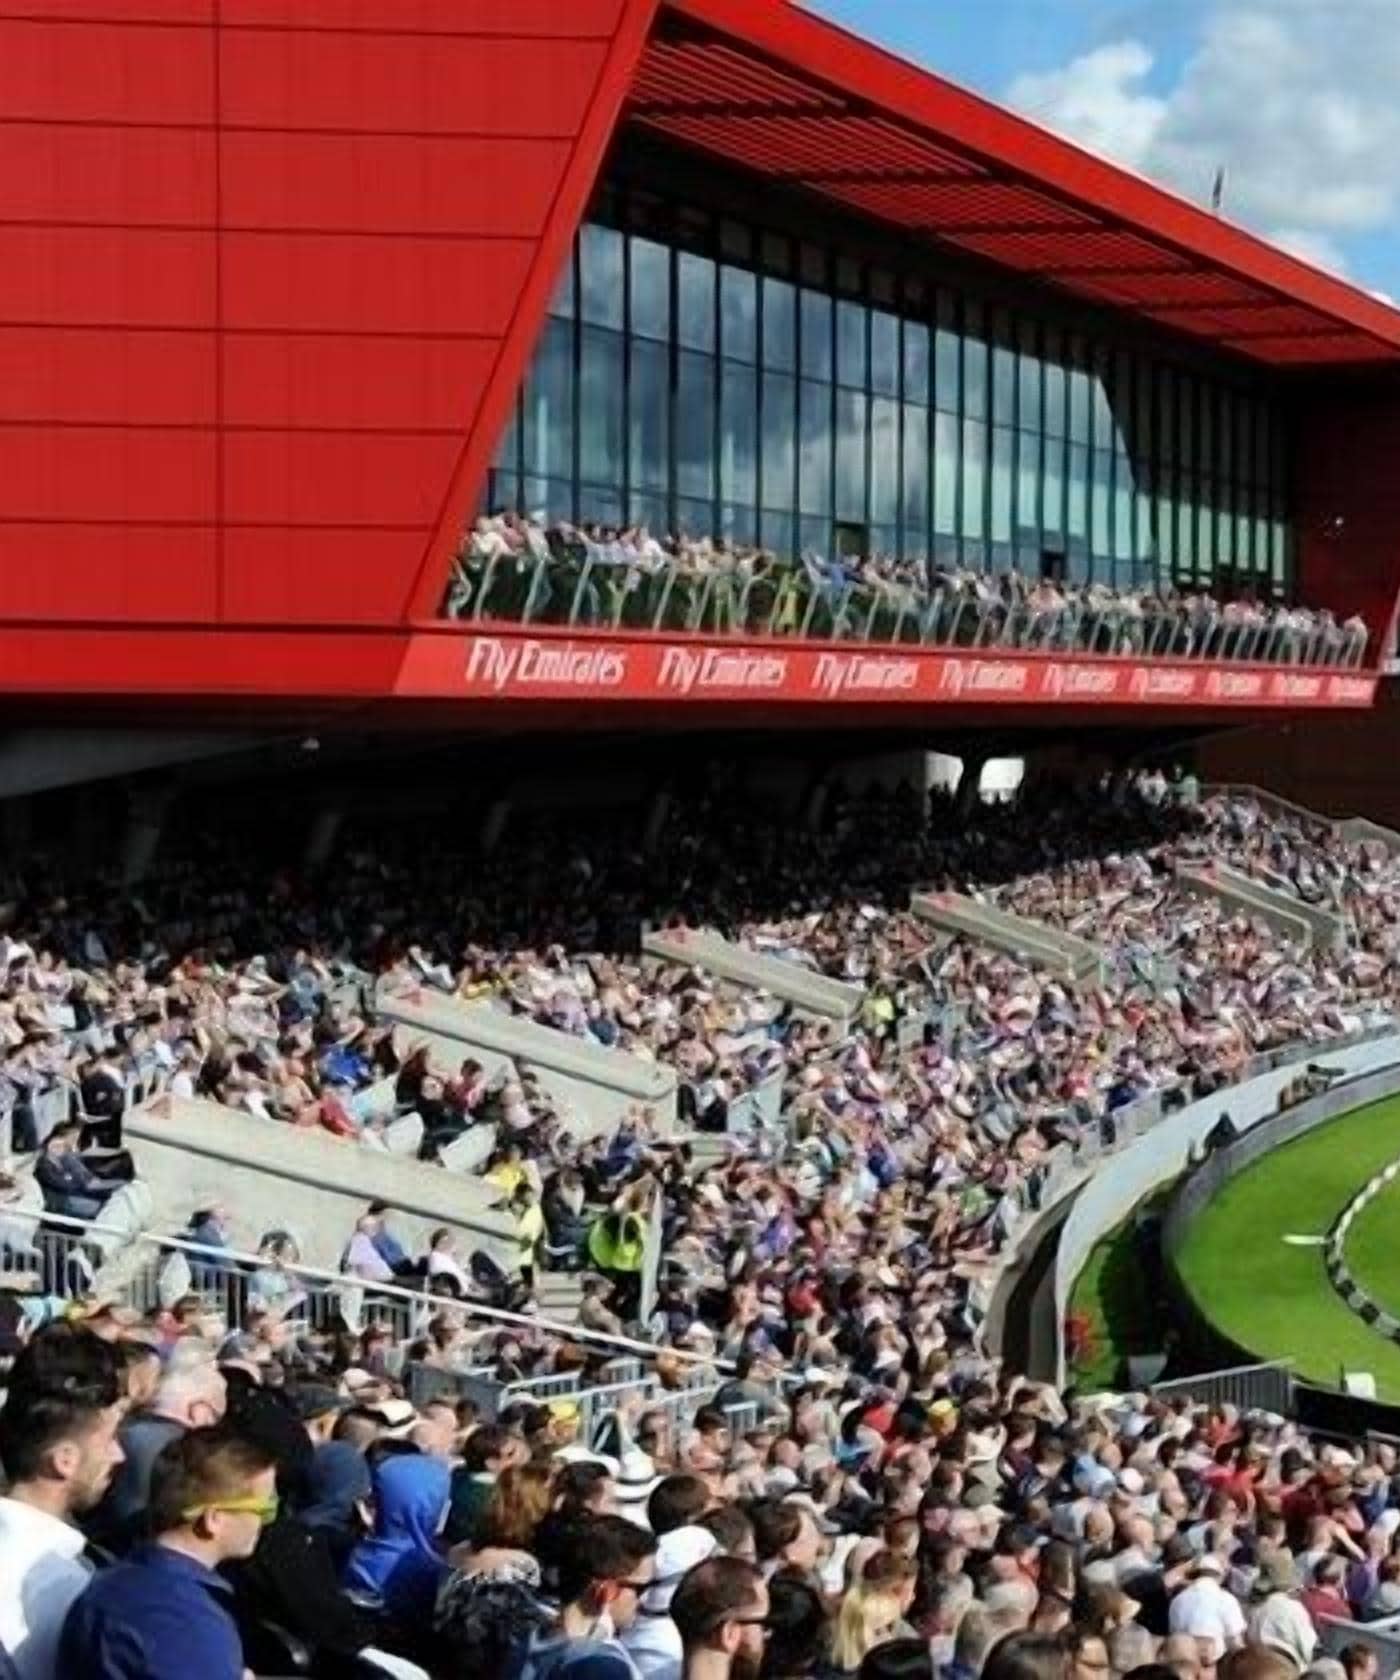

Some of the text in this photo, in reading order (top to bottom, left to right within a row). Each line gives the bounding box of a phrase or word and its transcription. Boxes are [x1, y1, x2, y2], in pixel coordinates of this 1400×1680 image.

[466, 636, 627, 690] Fly Emirates
[657, 646, 700, 694] Fly
[811, 651, 847, 698] Fly
